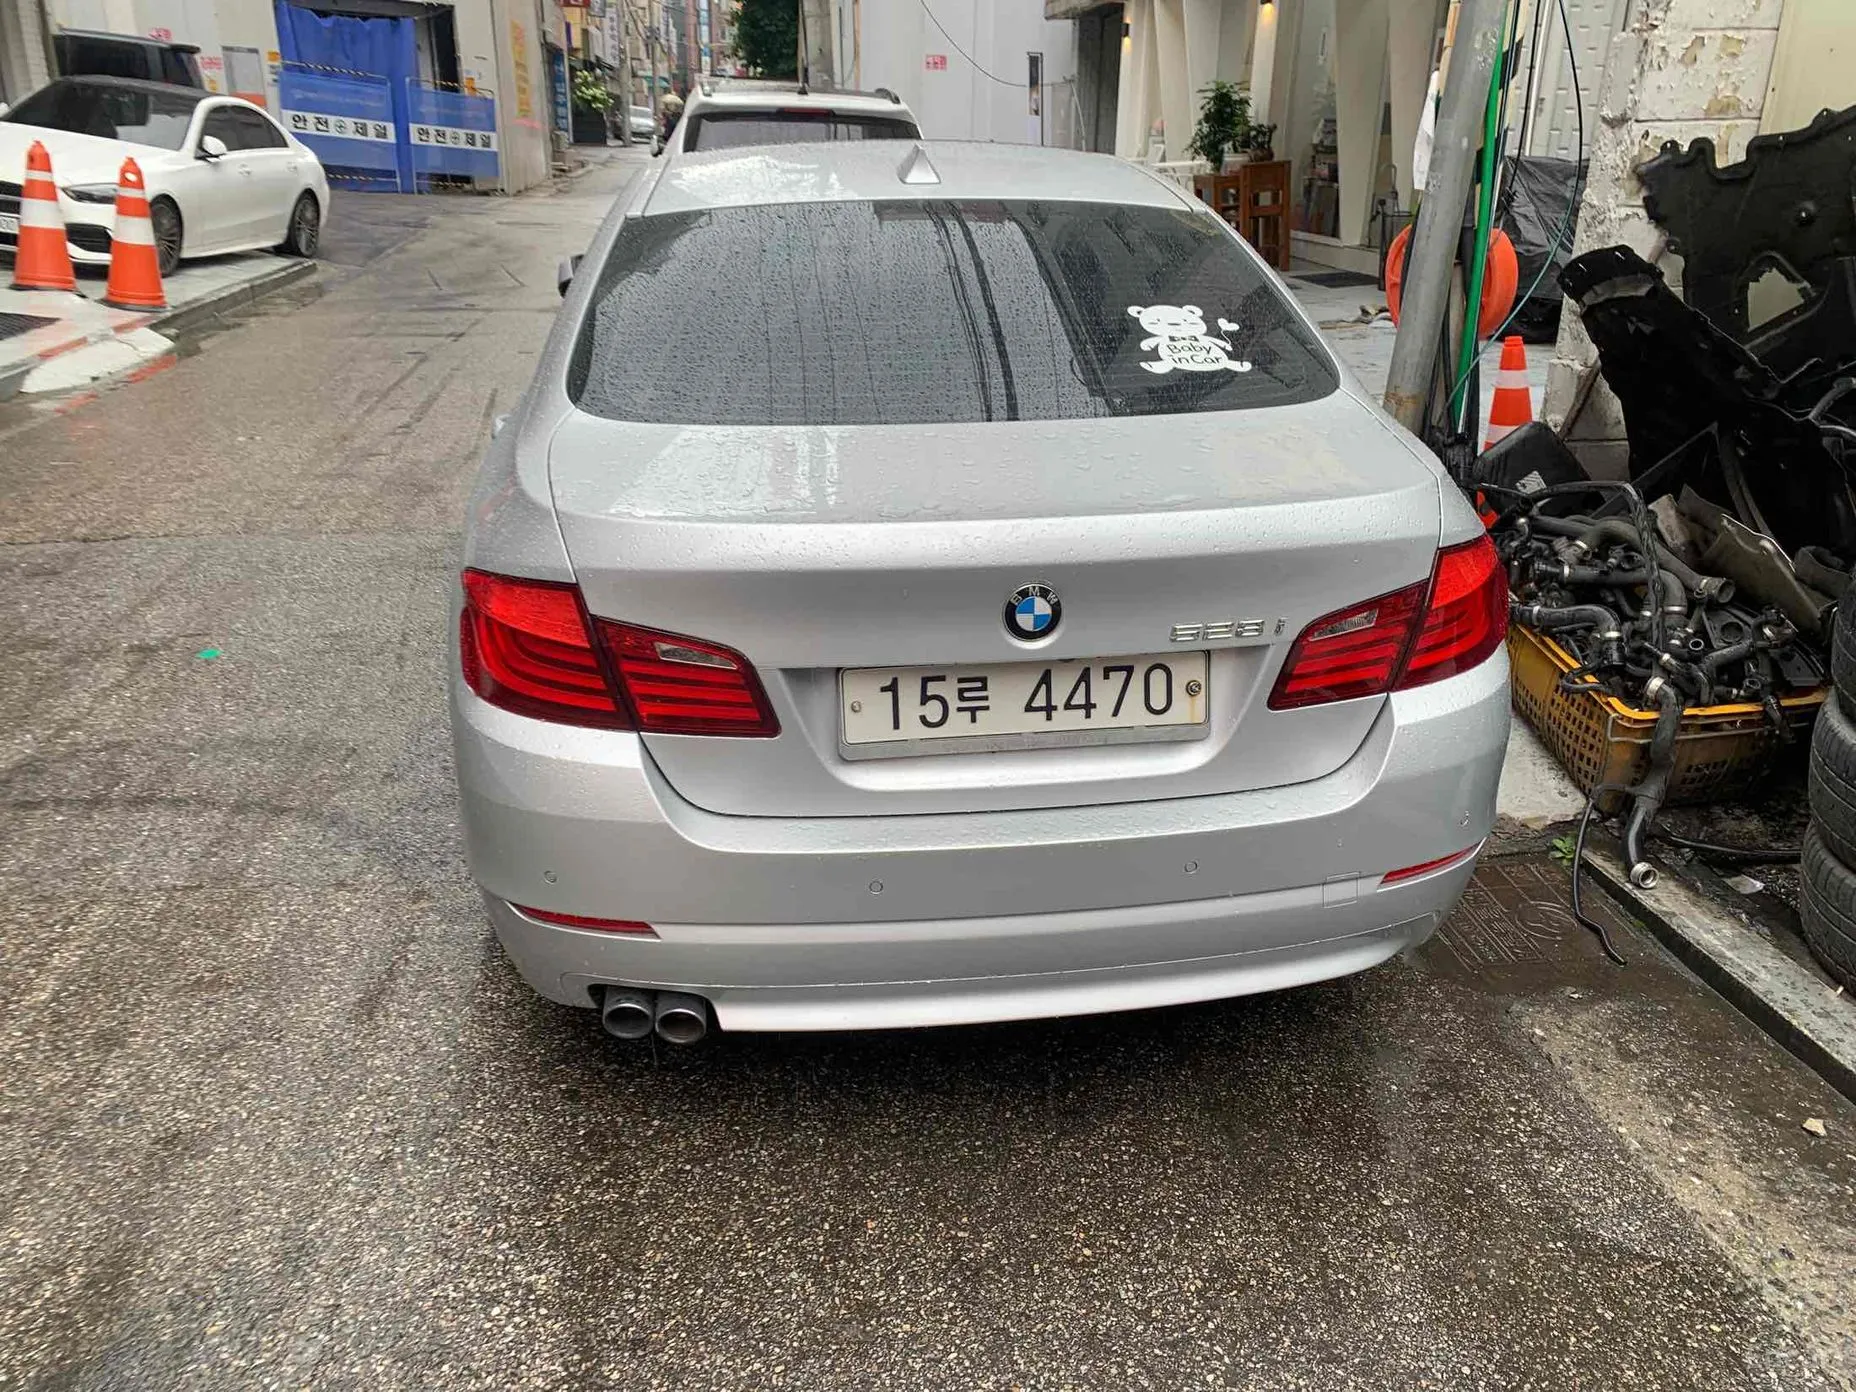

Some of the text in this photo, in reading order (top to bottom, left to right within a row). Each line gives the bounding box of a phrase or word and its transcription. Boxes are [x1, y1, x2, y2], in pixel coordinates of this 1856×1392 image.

[292, 113, 388, 139] 안전 제일
[416, 127, 492, 148] 안전 제일
[1166, 342, 1212, 354] Baby
[1010, 585, 1059, 605] BMW
[879, 663, 1173, 731] 15루 4470
